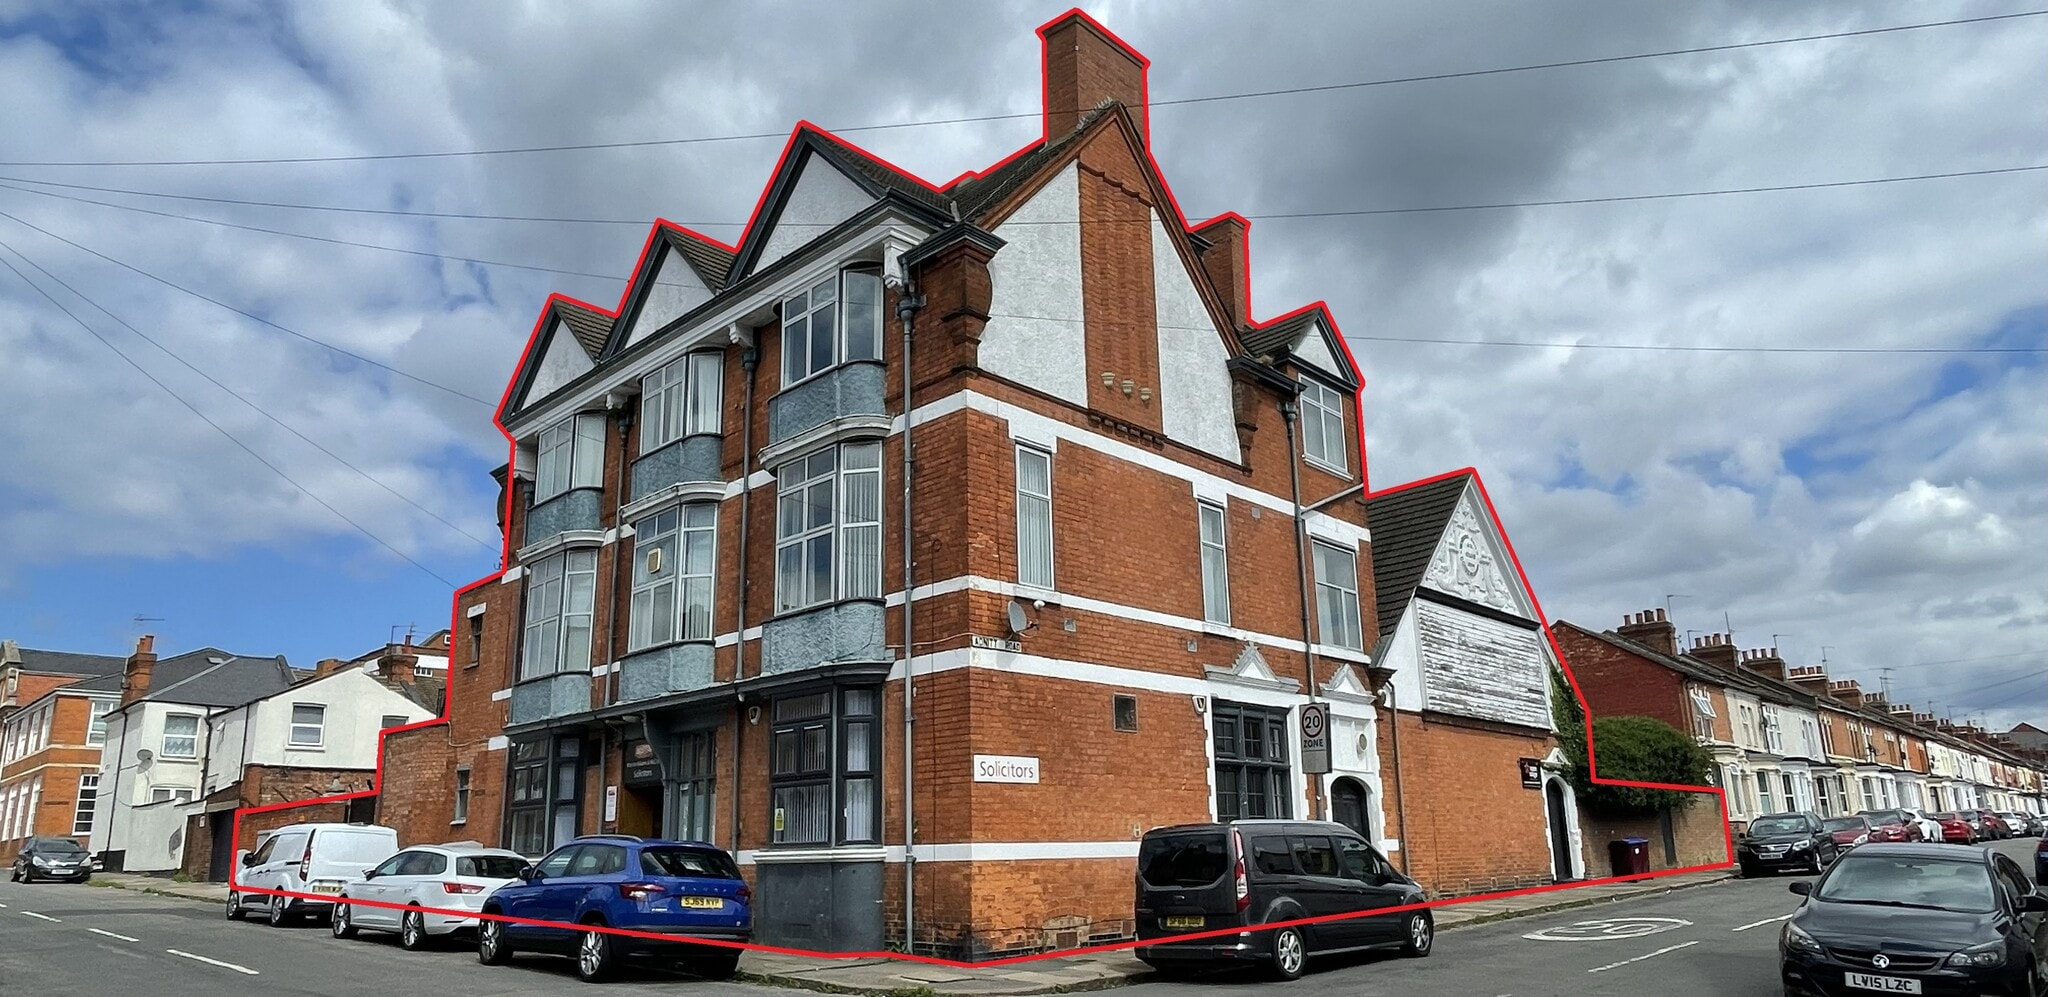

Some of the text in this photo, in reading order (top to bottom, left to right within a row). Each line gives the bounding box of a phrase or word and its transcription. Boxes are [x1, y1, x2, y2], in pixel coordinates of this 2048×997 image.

[1305, 715, 1320, 729] 20
[1304, 739, 1323, 748] ZONE
[980, 760, 1034, 778] Solicitors
[1852, 975, 1912, 992] LV15 LZC
